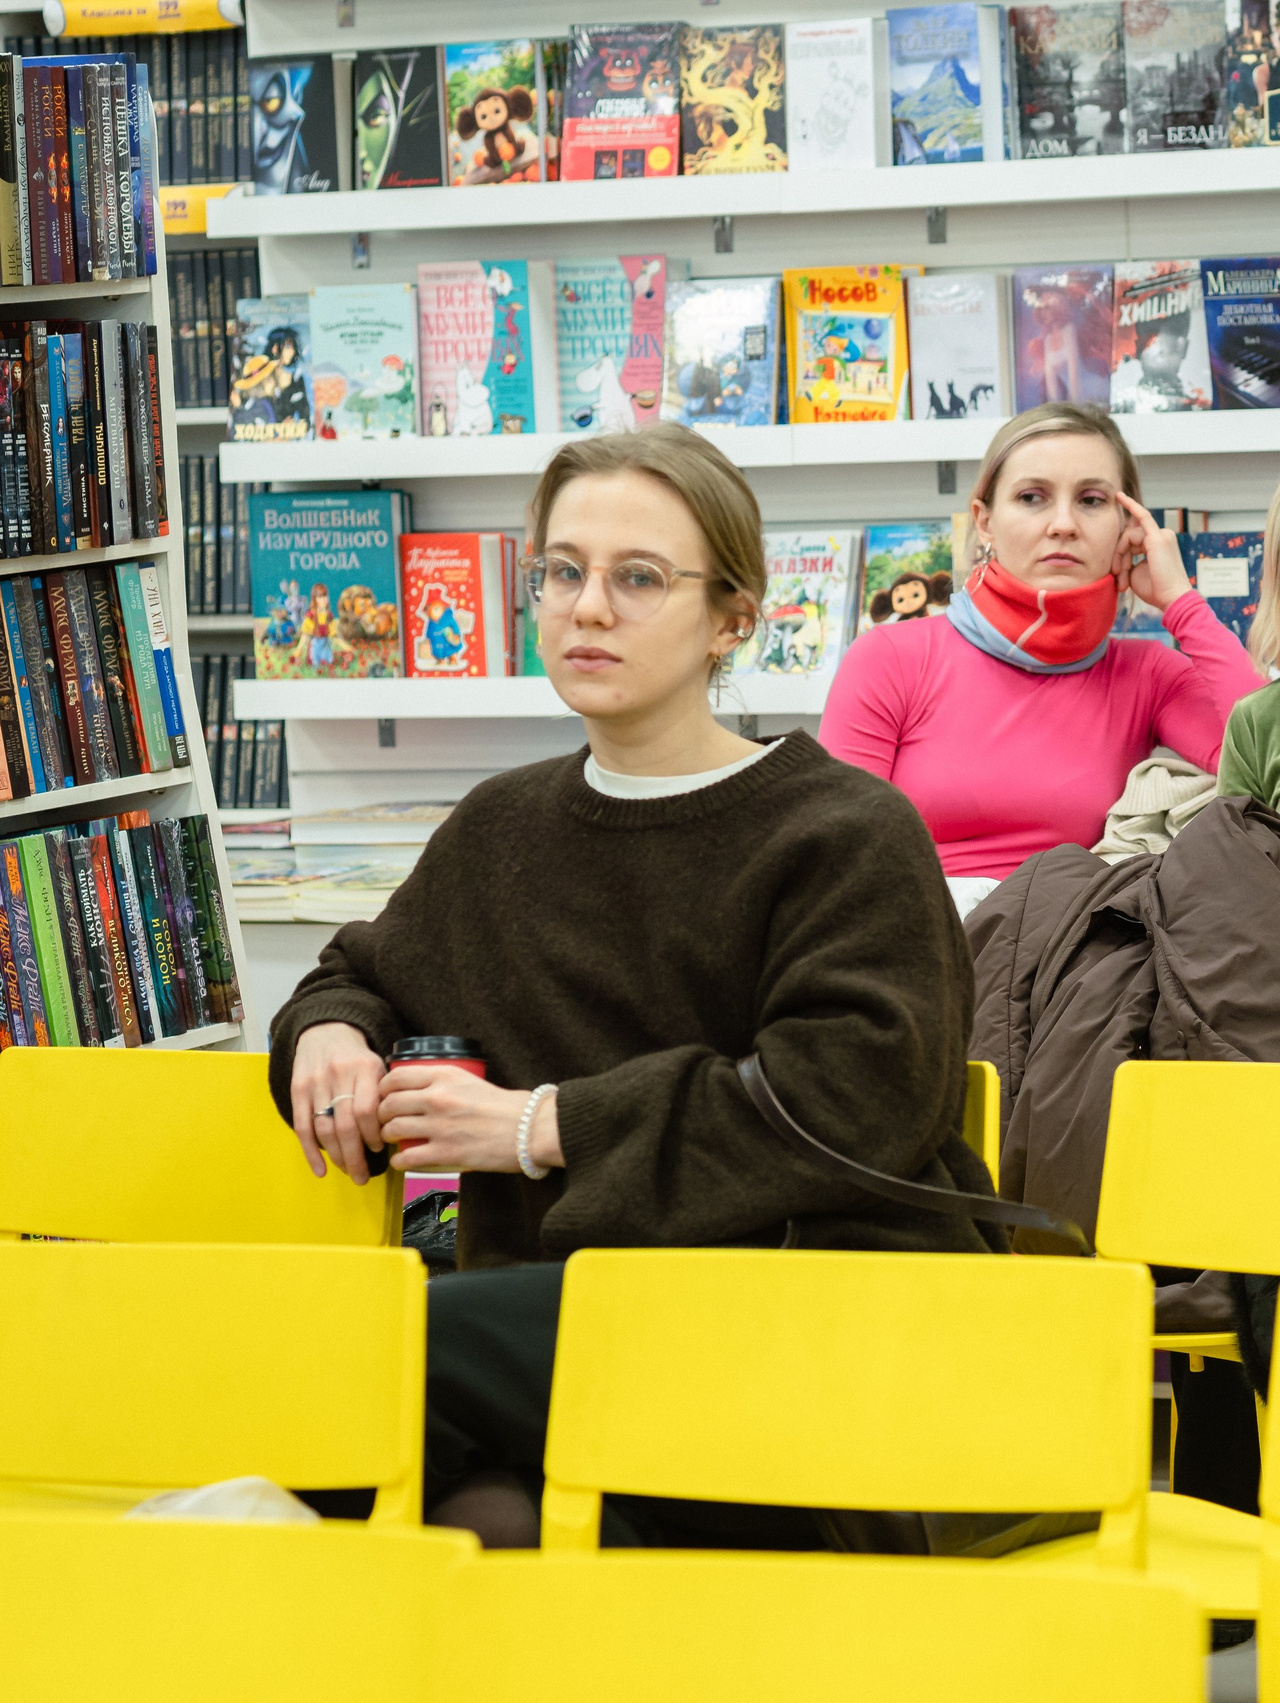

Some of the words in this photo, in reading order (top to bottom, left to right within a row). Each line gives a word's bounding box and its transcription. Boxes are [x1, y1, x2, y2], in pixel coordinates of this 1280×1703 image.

[2, 84, 12, 151] ВАЛИНОРА
[33, 78, 43, 158] ФАМИЛЬЯРАМ
[42, 85, 52, 139] РОССИ
[53, 85, 65, 139] РОССИ
[114, 97, 130, 158] ПЕШКА
[130, 84, 140, 143] КАРНАВАЛ
[101, 97, 112, 166] ИСПОВЕДЬ
[1026, 138, 1069, 159] ДОМ
[104, 170, 118, 255] ДЕМОНОЛОГА
[119, 170, 135, 255] КОРОЛЕВЫ
[7, 244, 17, 277] НИК
[93, 366, 102, 411] Стрельченко
[137, 380, 145, 396] ЗА
[70, 414, 85, 445] ТАМ
[109, 396, 119, 454] МЕРТВЫХ
[139, 398, 151, 465] ОКОЛИЦЕЙ
[39, 403, 54, 488] БЕССМЕРТНИК
[79, 463, 85, 474] ТЭ
[112, 459, 121, 489] ДУШ
[80, 477, 88, 518] КРИСТИНА
[144, 475, 153, 507] ТЬМА
[263, 508, 381, 530] ВОЛШЕБНИК
[258, 529, 389, 551] ИЗУМРУДНОГО
[289, 551, 361, 571] ГОРОДА
[128, 579, 138, 610] Фуллер
[135, 630, 145, 642] ИЗ
[136, 643, 148, 669] РОДА
[142, 633, 157, 685] ПОСЛЕДНЯЯ
[162, 655, 170, 673] КОГДА
[142, 670, 152, 690] МУН
[165, 674, 175, 698] ЗАПОЮТ
[23, 699, 33, 719] ЧУБ
[170, 699, 180, 730] МЕРТВЕЦЫ
[27, 721, 39, 754] ЗЕМЛИ
[174, 735, 188, 759] ВЕЦЫ
[78, 868, 94, 923] ПОЙМАТЬ
[86, 867, 106, 946] МОНСТРА
[88, 923, 99, 948] КАК
[151, 917, 161, 928] И
[153, 931, 171, 986] ВОРОН
[161, 918, 177, 976] СОКОЛ
[108, 919, 126, 988] ВЕЛИКОГО
[120, 990, 133, 1026] ЛЕСА
[120, 950, 132, 995] ПТИЦЫ
[190, 935, 208, 998] kaissa
